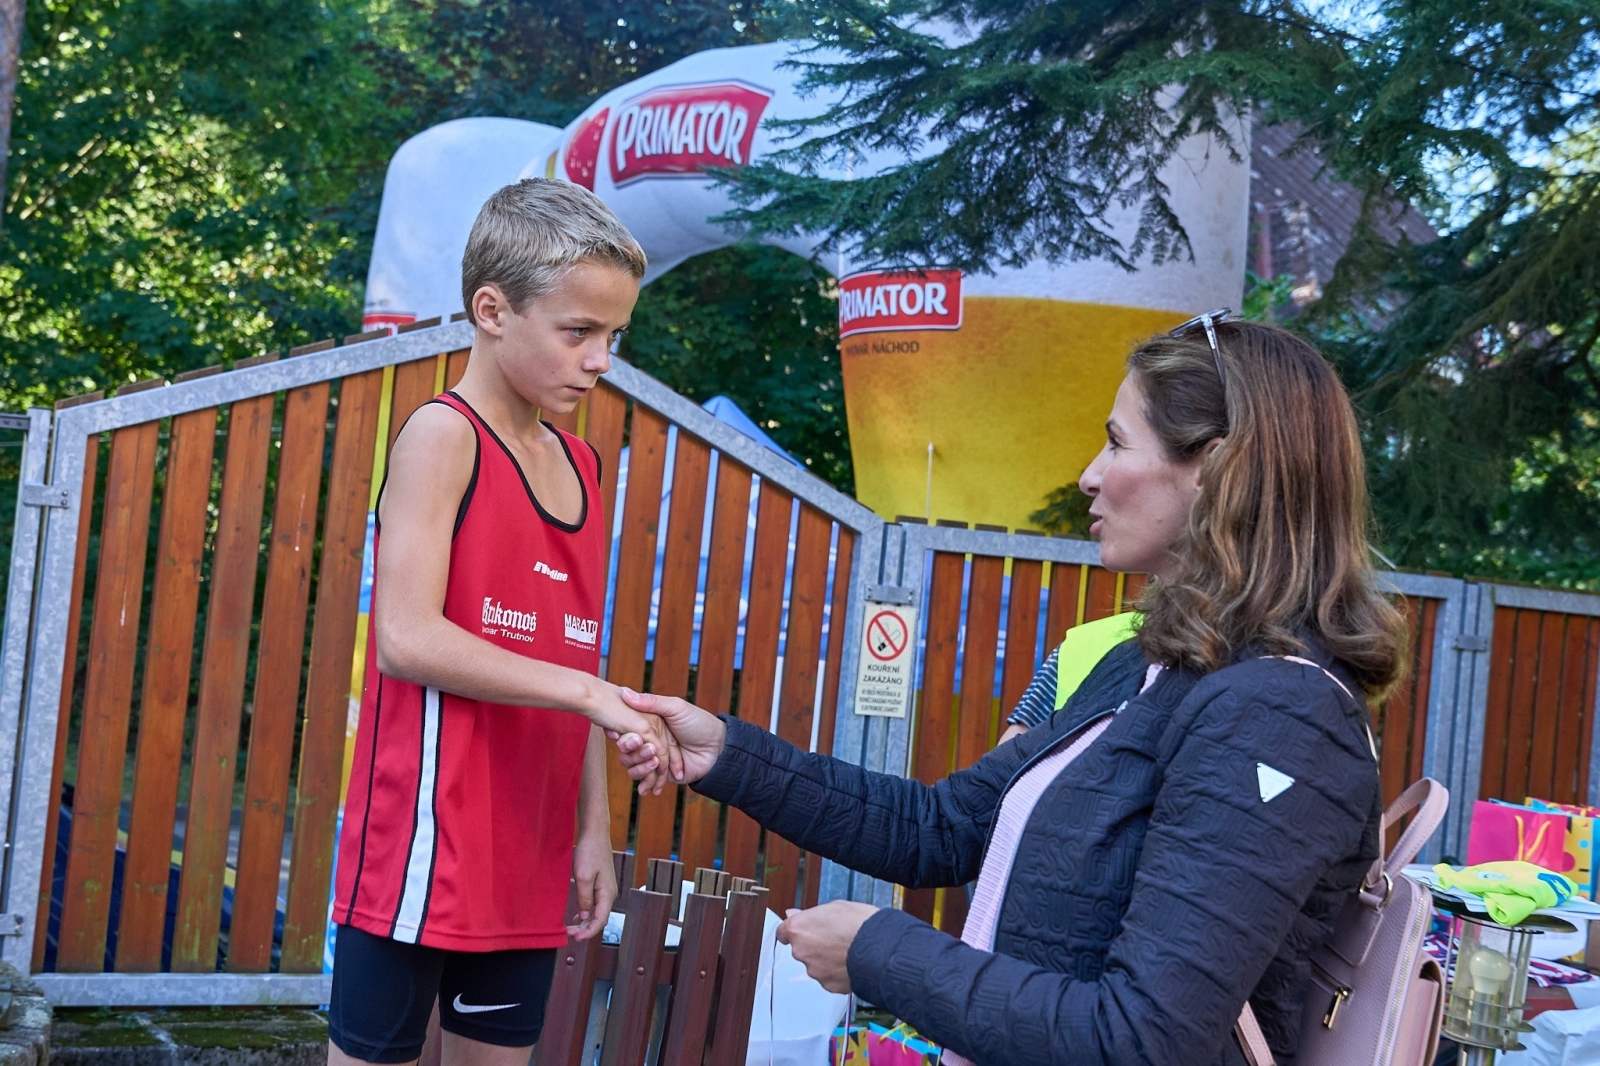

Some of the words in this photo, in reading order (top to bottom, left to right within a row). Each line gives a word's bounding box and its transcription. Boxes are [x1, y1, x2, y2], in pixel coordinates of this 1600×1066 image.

[500, 628, 535, 643] Trutnov
[867, 664, 900, 673] KOUŘENÍ
[863, 675, 903, 685] ZAKÁZÁNO
